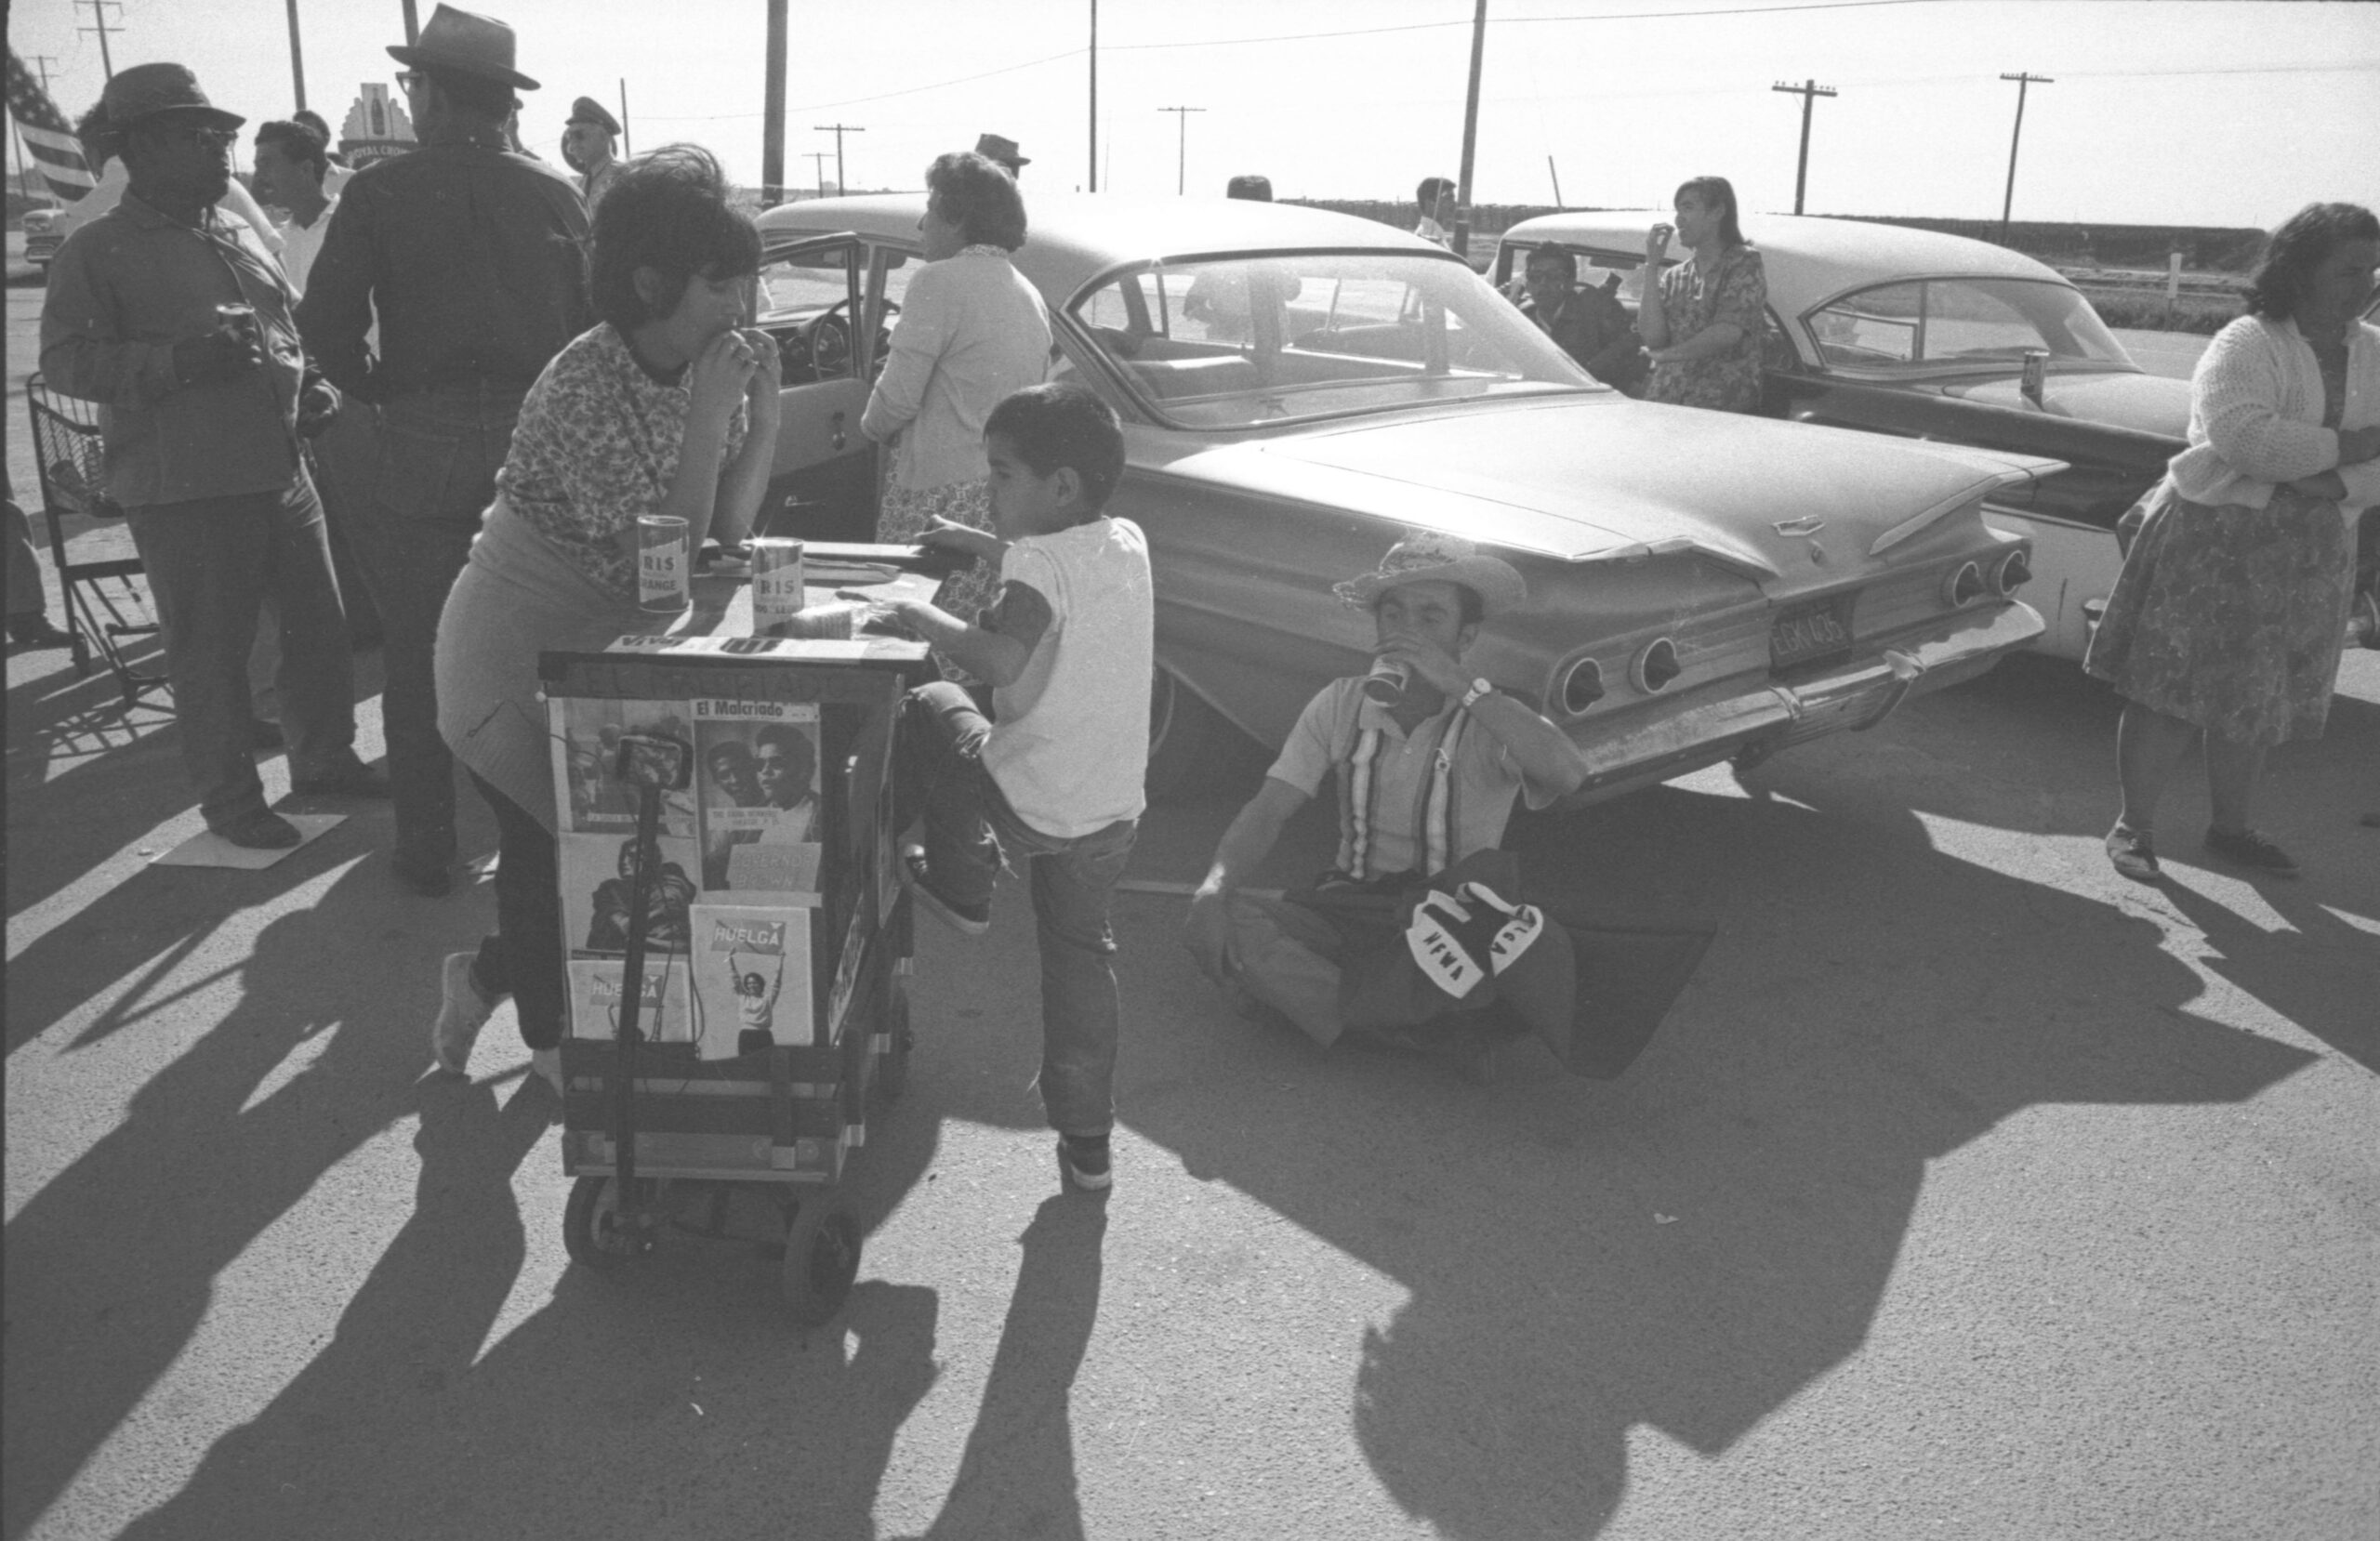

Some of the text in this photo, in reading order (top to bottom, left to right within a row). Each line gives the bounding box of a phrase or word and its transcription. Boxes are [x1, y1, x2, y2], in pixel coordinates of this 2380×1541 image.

[348, 145, 379, 158] ROYAL
[640, 578, 678, 591] RANGE
[696, 701, 784, 717] El Malcriado
[714, 927, 780, 945] HUELGA
[592, 981, 657, 998] HUEGA
